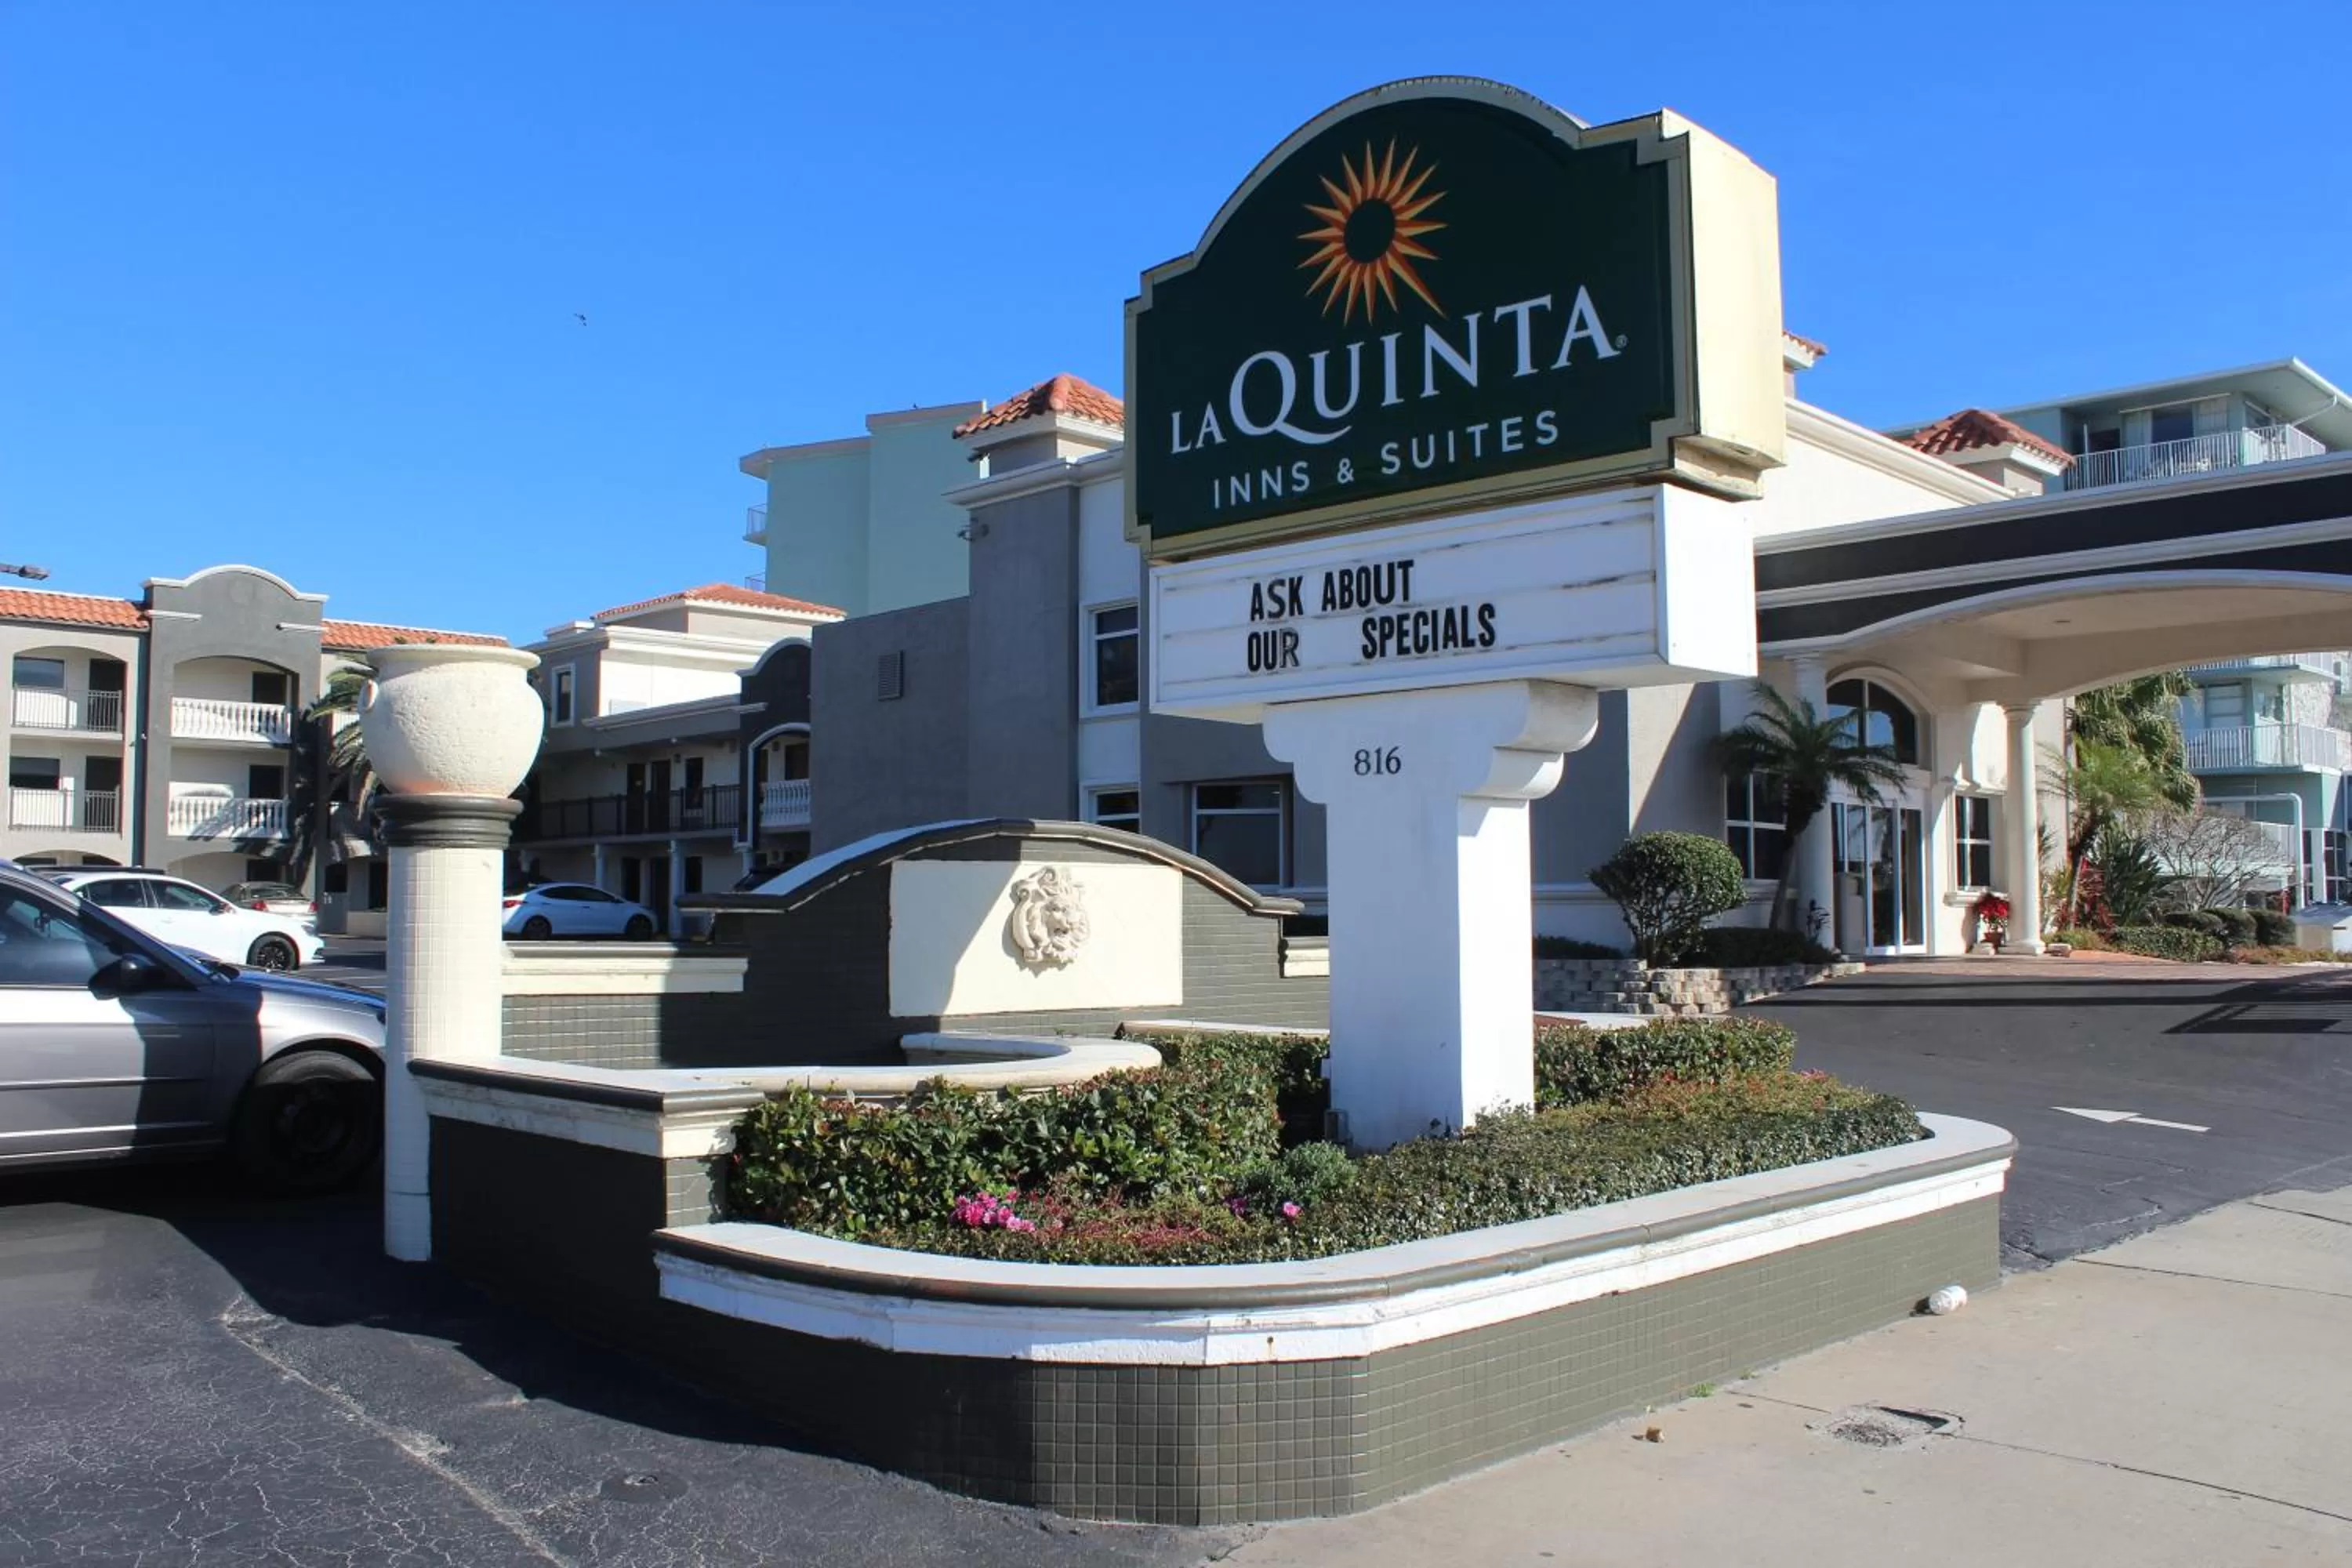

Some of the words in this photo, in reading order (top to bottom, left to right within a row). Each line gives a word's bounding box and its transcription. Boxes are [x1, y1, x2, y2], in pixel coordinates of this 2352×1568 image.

[1170, 400, 1226, 455] LA
[1228, 284, 1621, 445] QUINTA
[1213, 461, 1310, 510] INNS
[1337, 457, 1356, 484] &
[1380, 409, 1560, 475] SUITES
[1250, 575, 1305, 622] ASK
[1321, 559, 1414, 612] ABOUT
[1247, 627, 1300, 673] OUR
[1361, 603, 1497, 659] SPECIALS
[1353, 746, 1402, 776] 816
